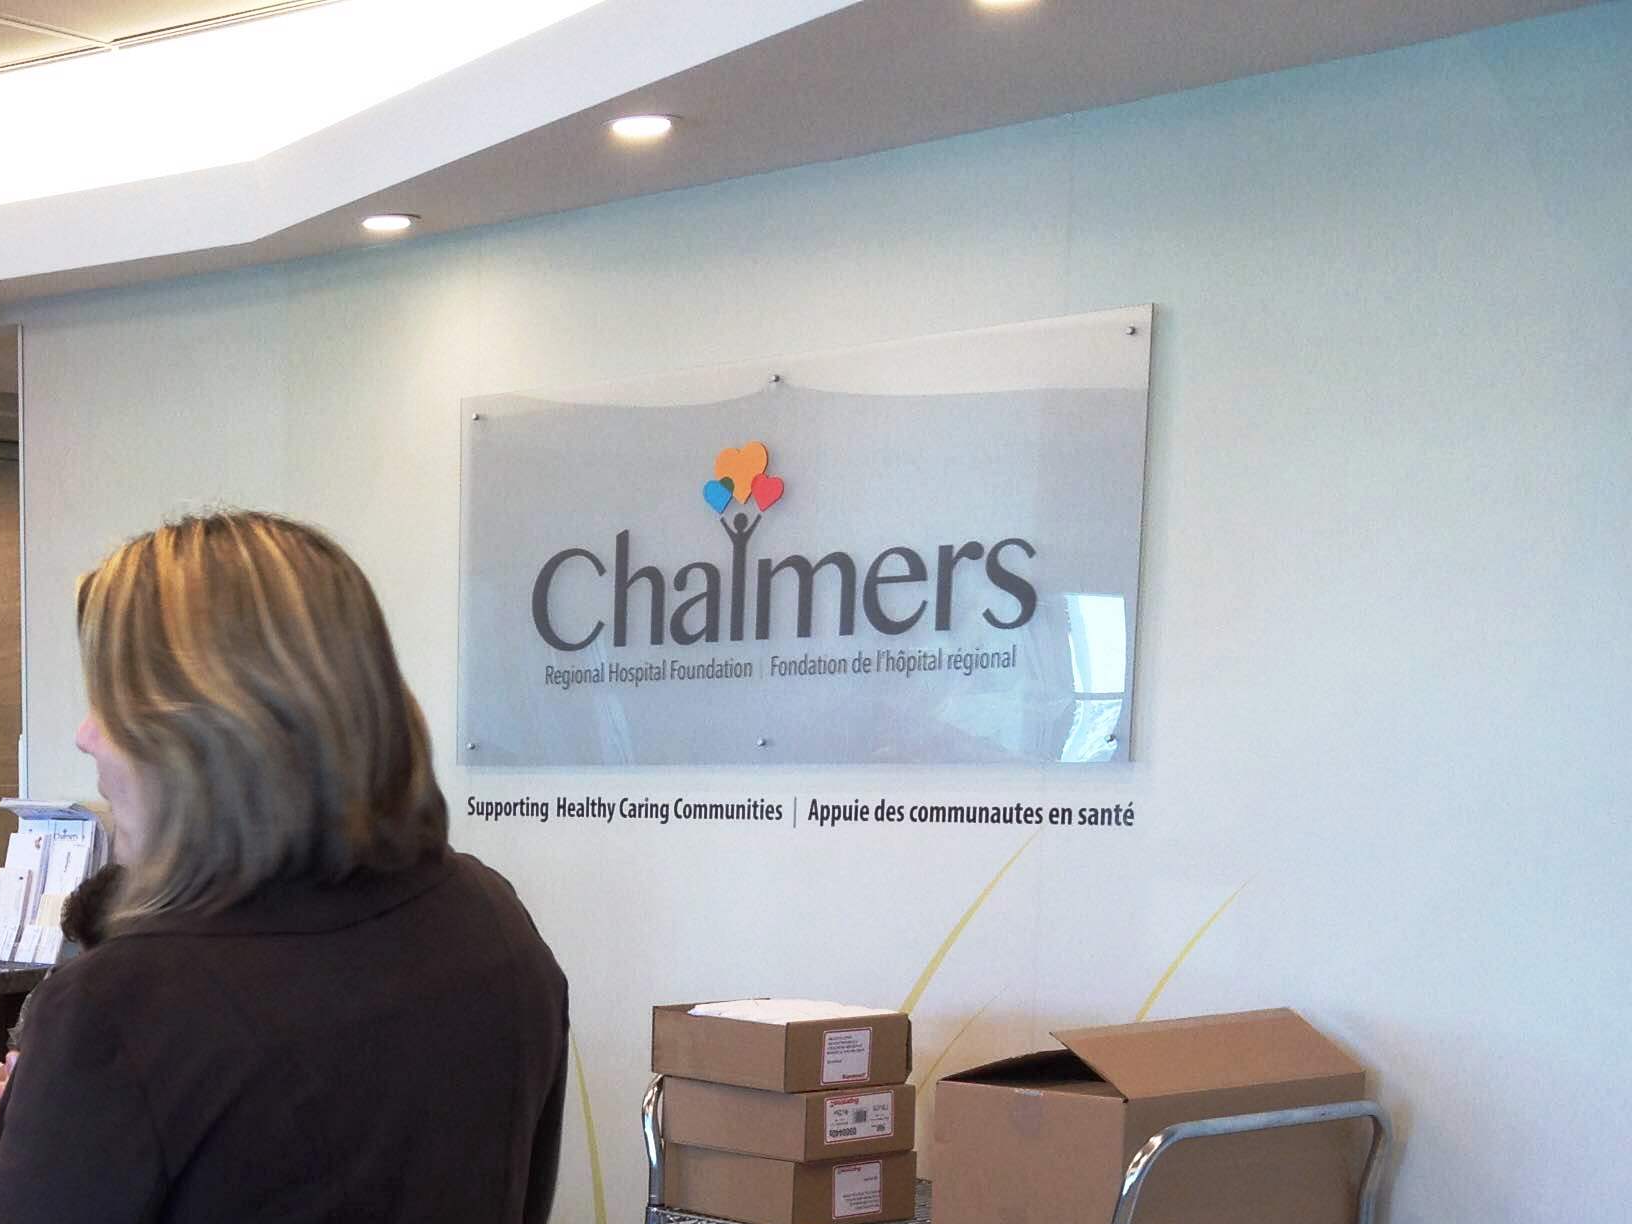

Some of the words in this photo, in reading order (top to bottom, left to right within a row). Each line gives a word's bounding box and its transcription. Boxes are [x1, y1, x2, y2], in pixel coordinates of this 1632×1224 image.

[532, 512, 1037, 652] Chalmers
[545, 663, 605, 690] Regional
[608, 660, 666, 687] Hospital
[670, 657, 752, 681] Foundation
[770, 653, 847, 677] Fondation
[851, 651, 872, 674] de
[876, 648, 942, 678] l'hôpital
[946, 644, 1017, 676] régional
[467, 796, 549, 823] Supporting
[556, 797, 615, 823] Healthy
[619, 797, 669, 824] Caring
[673, 797, 783, 821] Communities
[808, 798, 869, 826] Appuie
[874, 799, 904, 822] des
[909, 802, 1044, 825] communautes
[1049, 806, 1072, 826] en
[1077, 801, 1135, 827] santé
